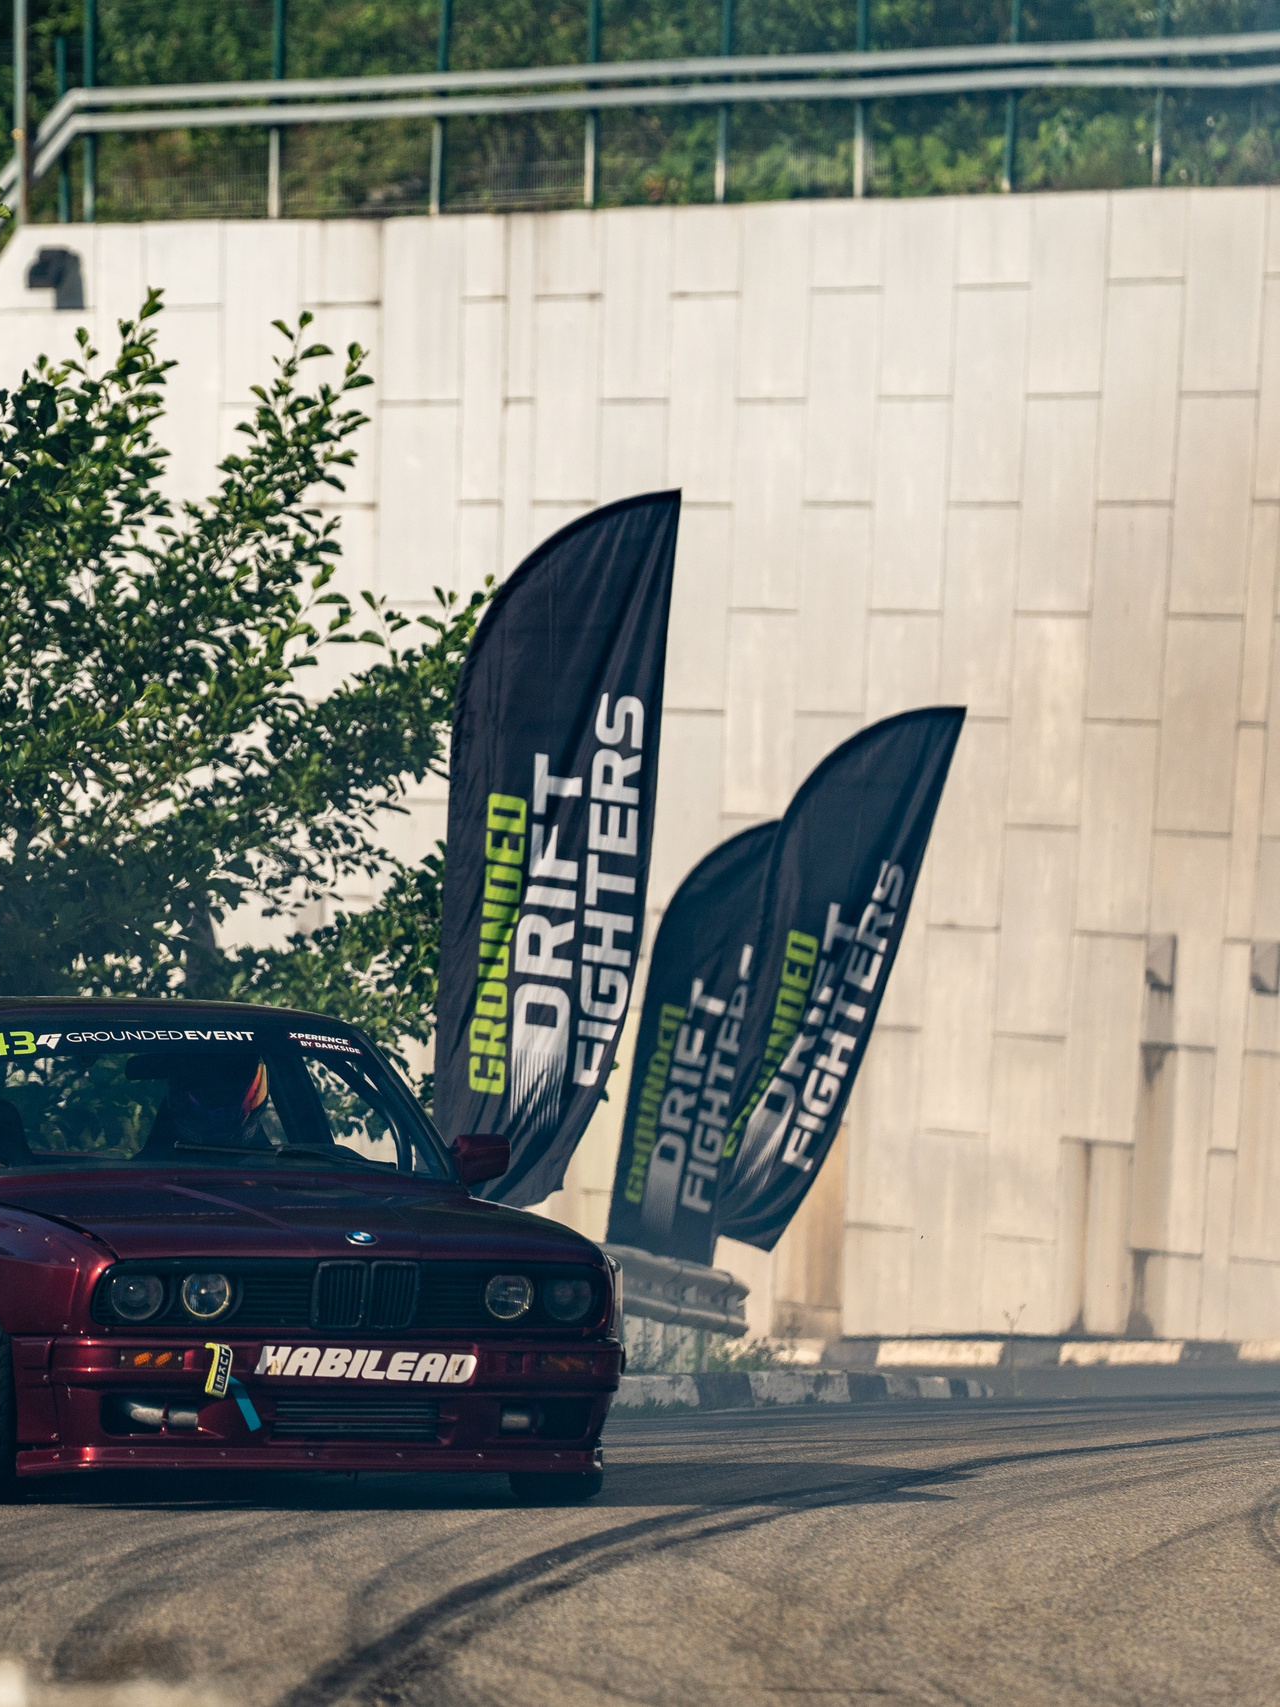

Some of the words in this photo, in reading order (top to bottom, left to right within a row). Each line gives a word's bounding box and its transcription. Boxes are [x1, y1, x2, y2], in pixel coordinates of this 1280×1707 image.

[469, 793, 527, 1095] GROUNDED
[511, 753, 583, 1130] DRIFT
[573, 692, 645, 1088] FIGHTERS
[782, 860, 905, 1173] FIGHTERS
[288, 1032, 349, 1045] XPERIENCE
[314, 1042, 362, 1054] DARKSIDE
[642, 978, 726, 1230] DRIFT
[253, 1345, 478, 1384] HABILEAD
